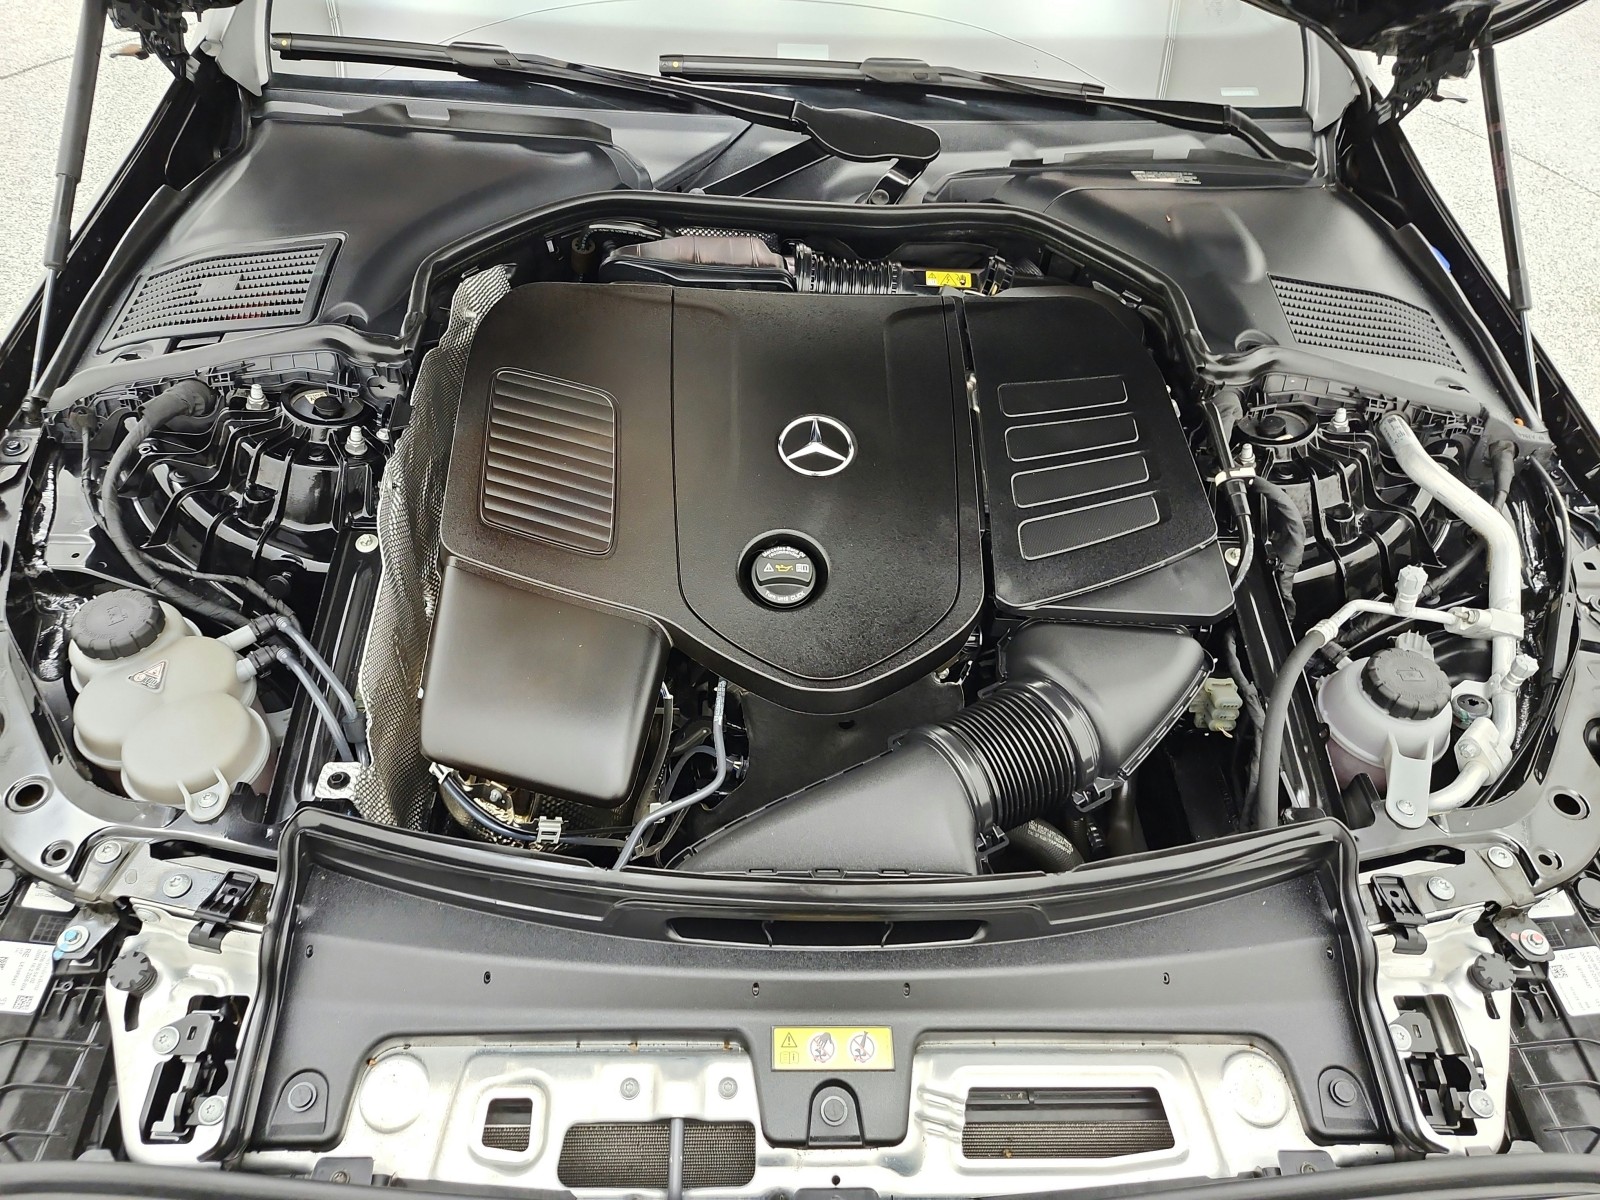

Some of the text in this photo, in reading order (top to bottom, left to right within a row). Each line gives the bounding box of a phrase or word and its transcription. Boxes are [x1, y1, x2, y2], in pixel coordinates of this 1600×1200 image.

[762, 546, 799, 557] Mercedes-Benz
[765, 590, 776, 600] Turn
[790, 590, 805, 600] CLICK
